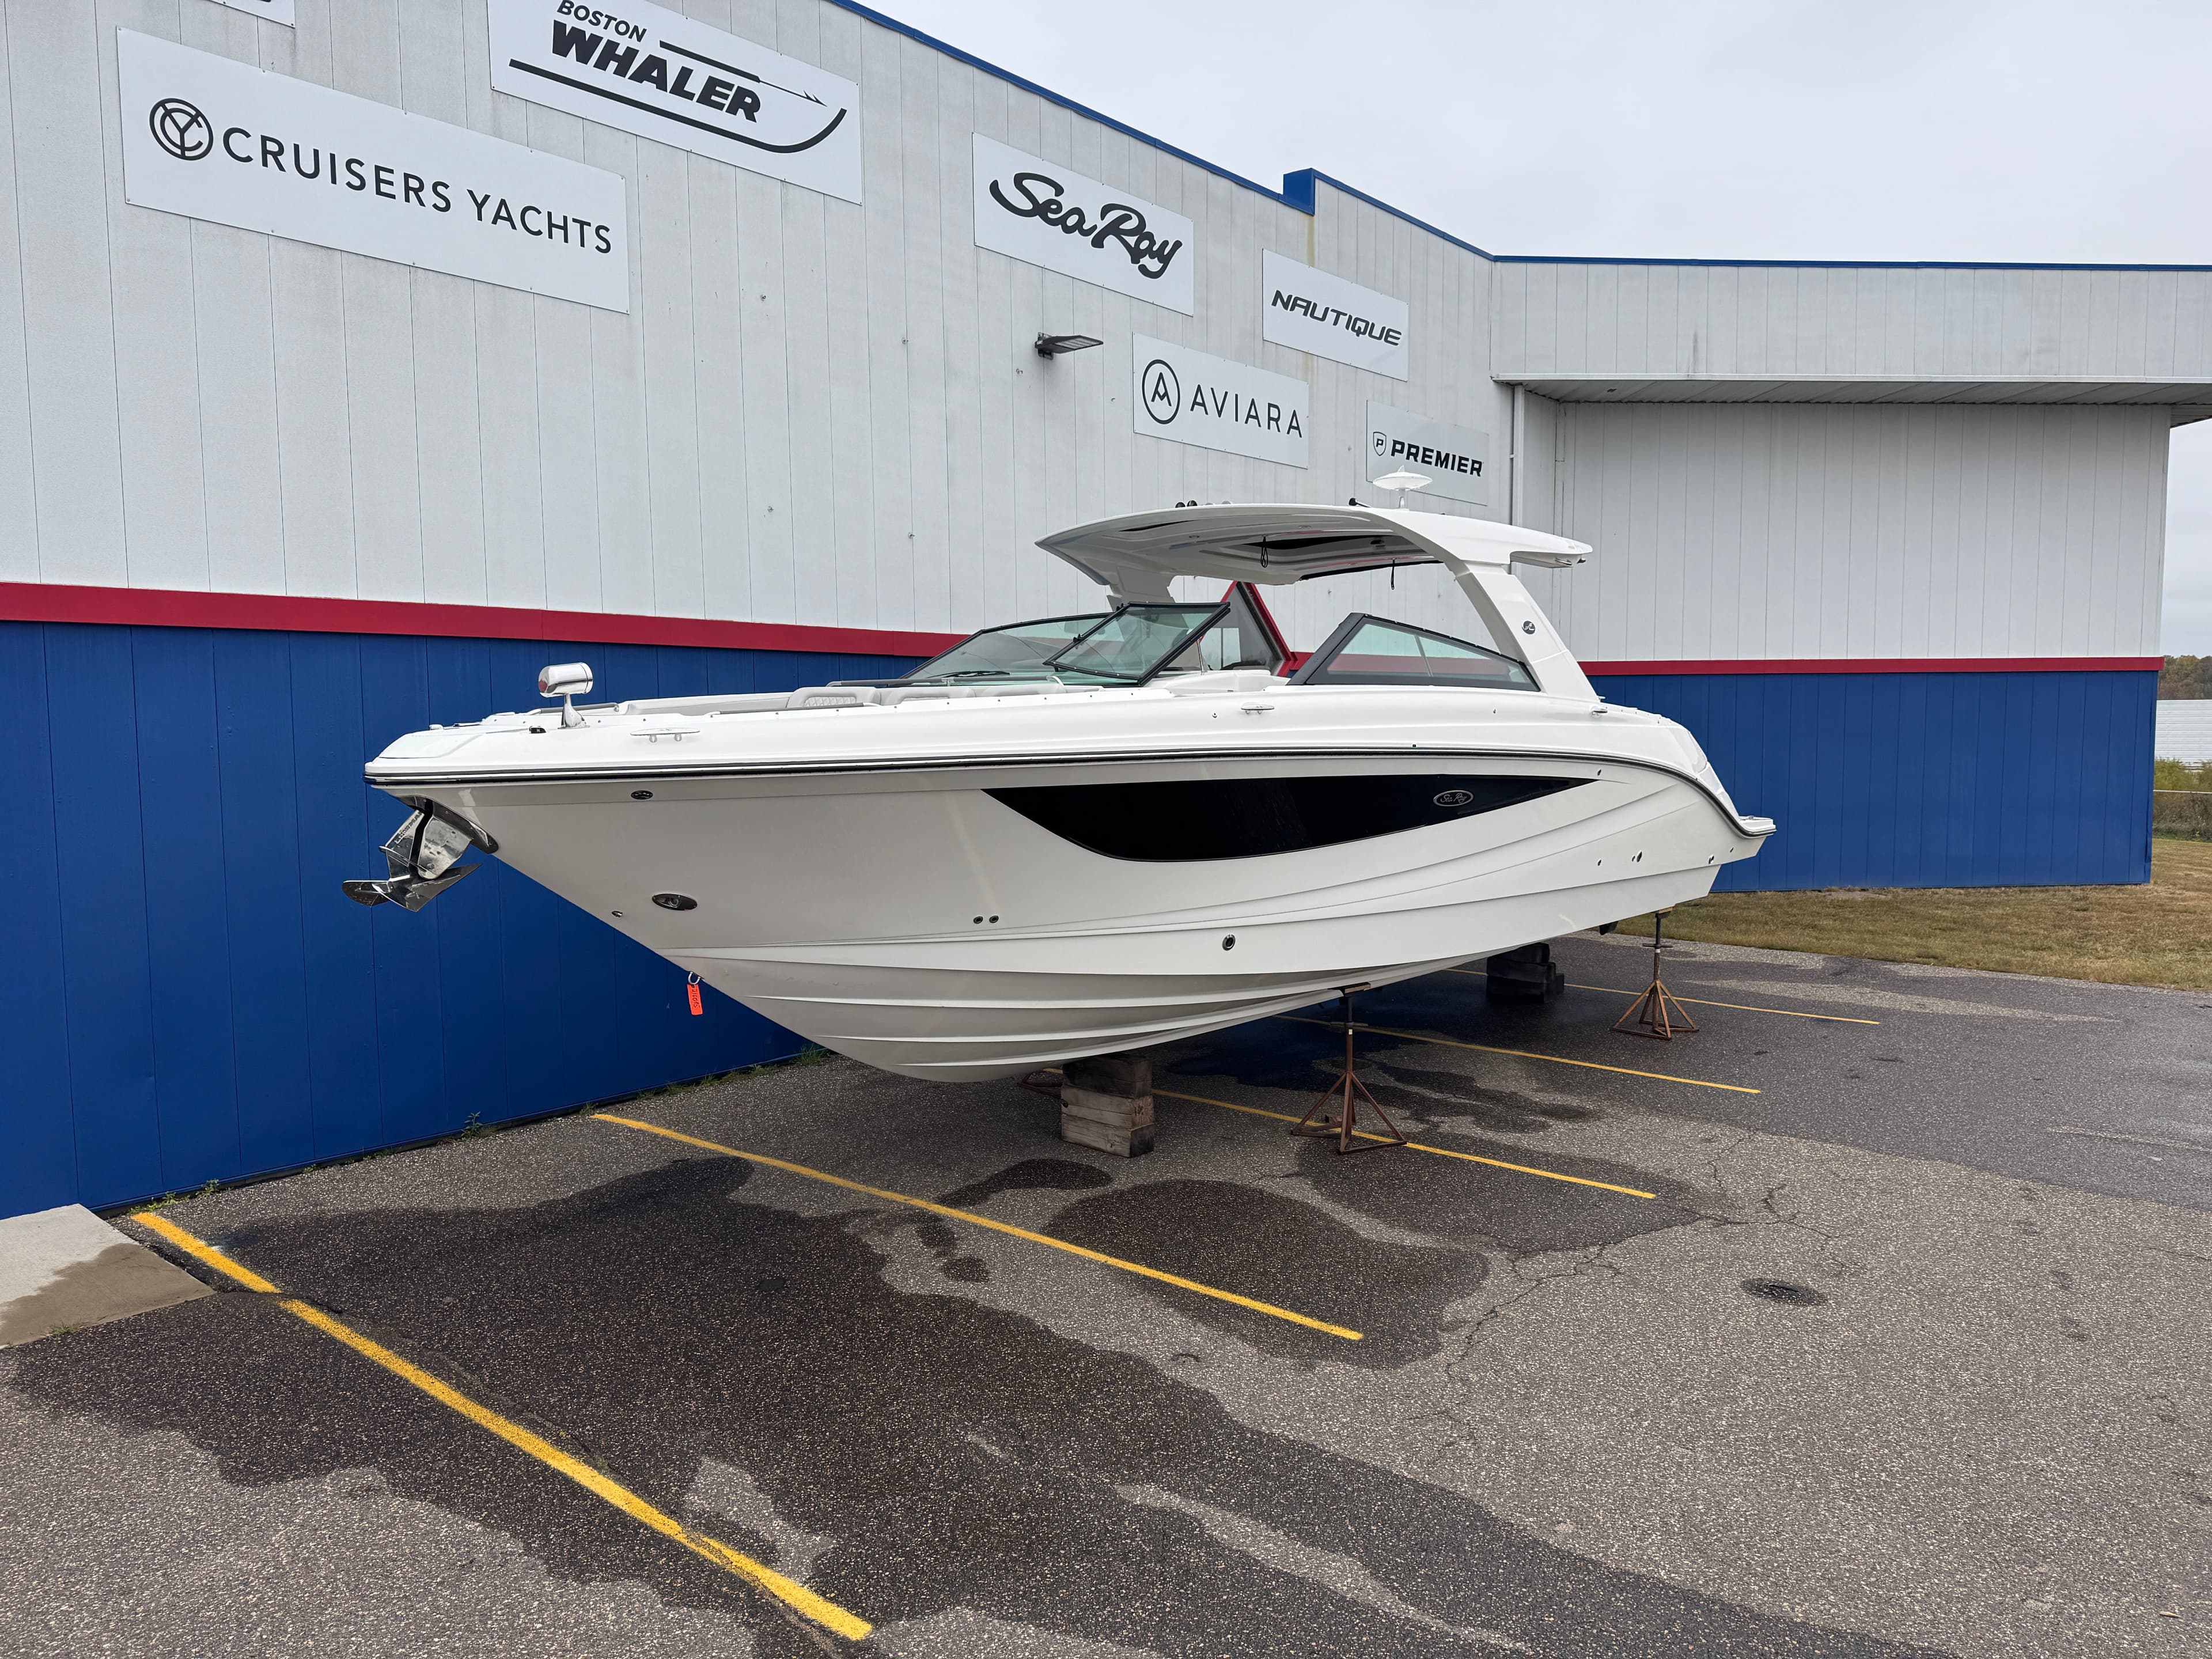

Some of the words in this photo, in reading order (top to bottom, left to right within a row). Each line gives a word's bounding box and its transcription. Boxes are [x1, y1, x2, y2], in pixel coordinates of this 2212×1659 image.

[557, 0, 647, 43] BOSTON
[552, 20, 761, 123] WHALER
[223, 127, 451, 213] CRUISERS
[467, 189, 611, 253] YACHTS
[989, 172, 1097, 237] Sea
[1091, 203, 1183, 279] Ray
[1271, 290, 1402, 346] NAUTIQUE
[1190, 384, 1302, 438] AVIARA
[1391, 439, 1483, 477] PREMIER
[1440, 794, 1453, 802] Sea
